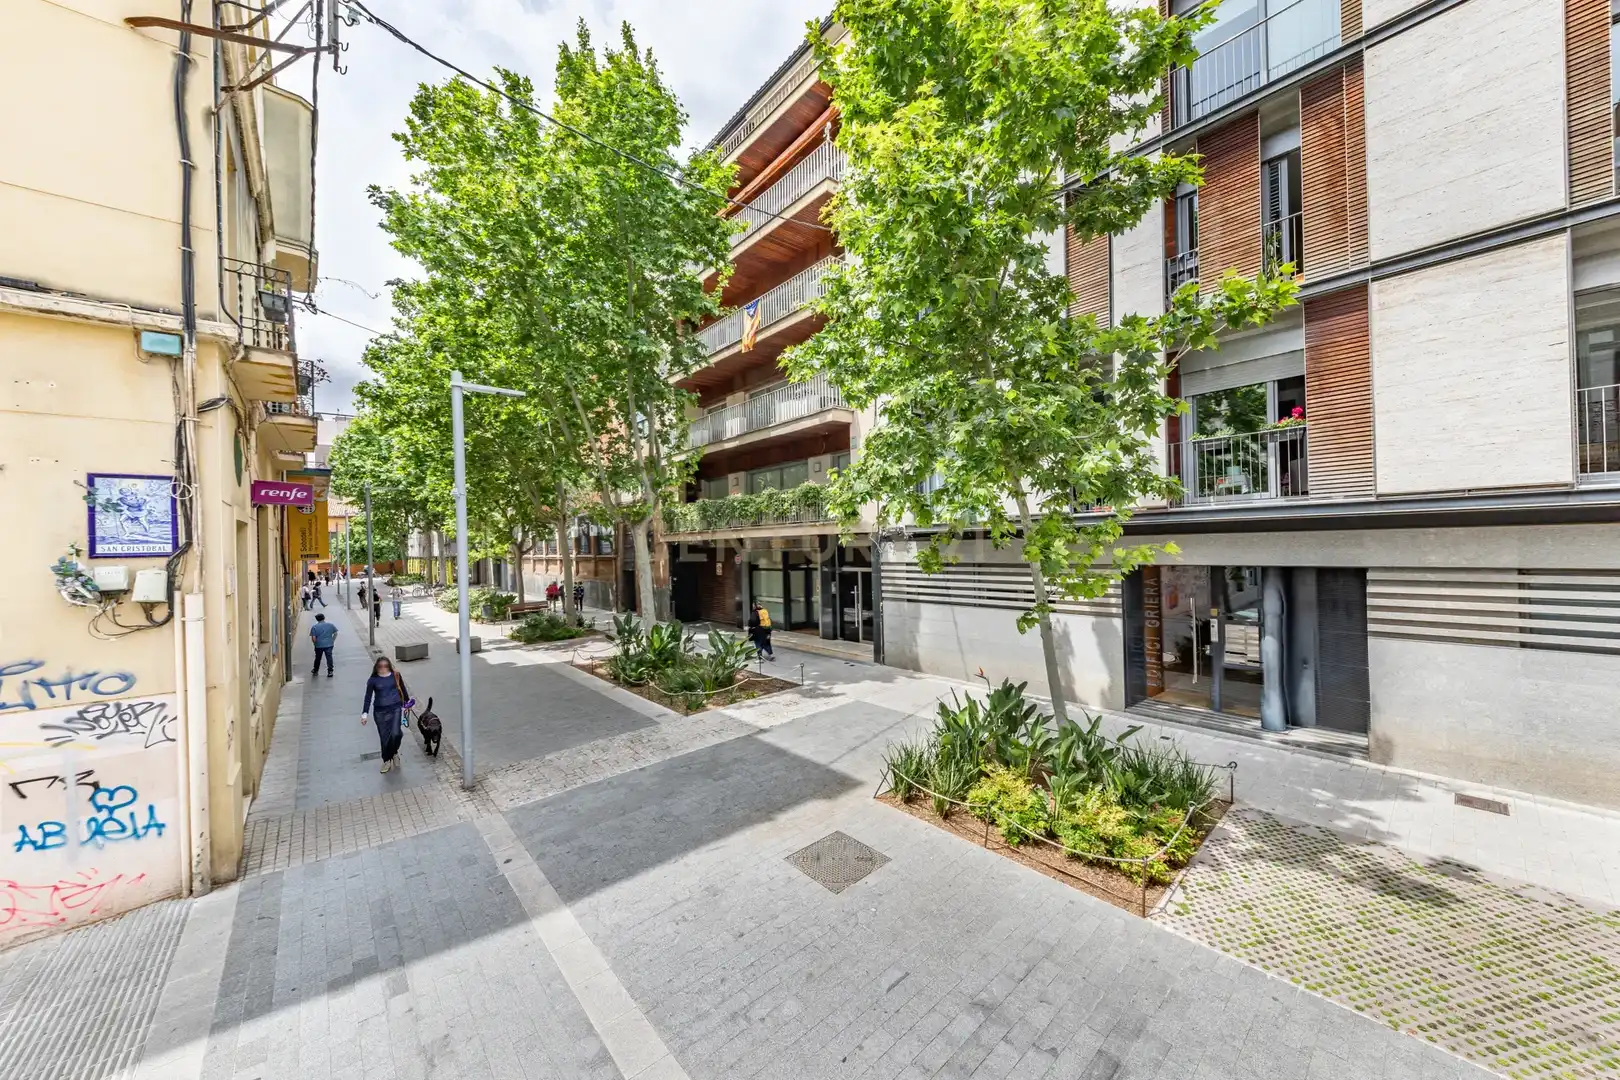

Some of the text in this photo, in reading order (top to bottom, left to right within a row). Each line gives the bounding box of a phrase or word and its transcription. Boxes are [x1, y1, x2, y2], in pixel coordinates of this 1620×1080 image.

[260, 487, 308, 501] renfe
[101, 545, 118, 553] SAN
[1143, 577, 1162, 688] EDIFICI GRIERA
